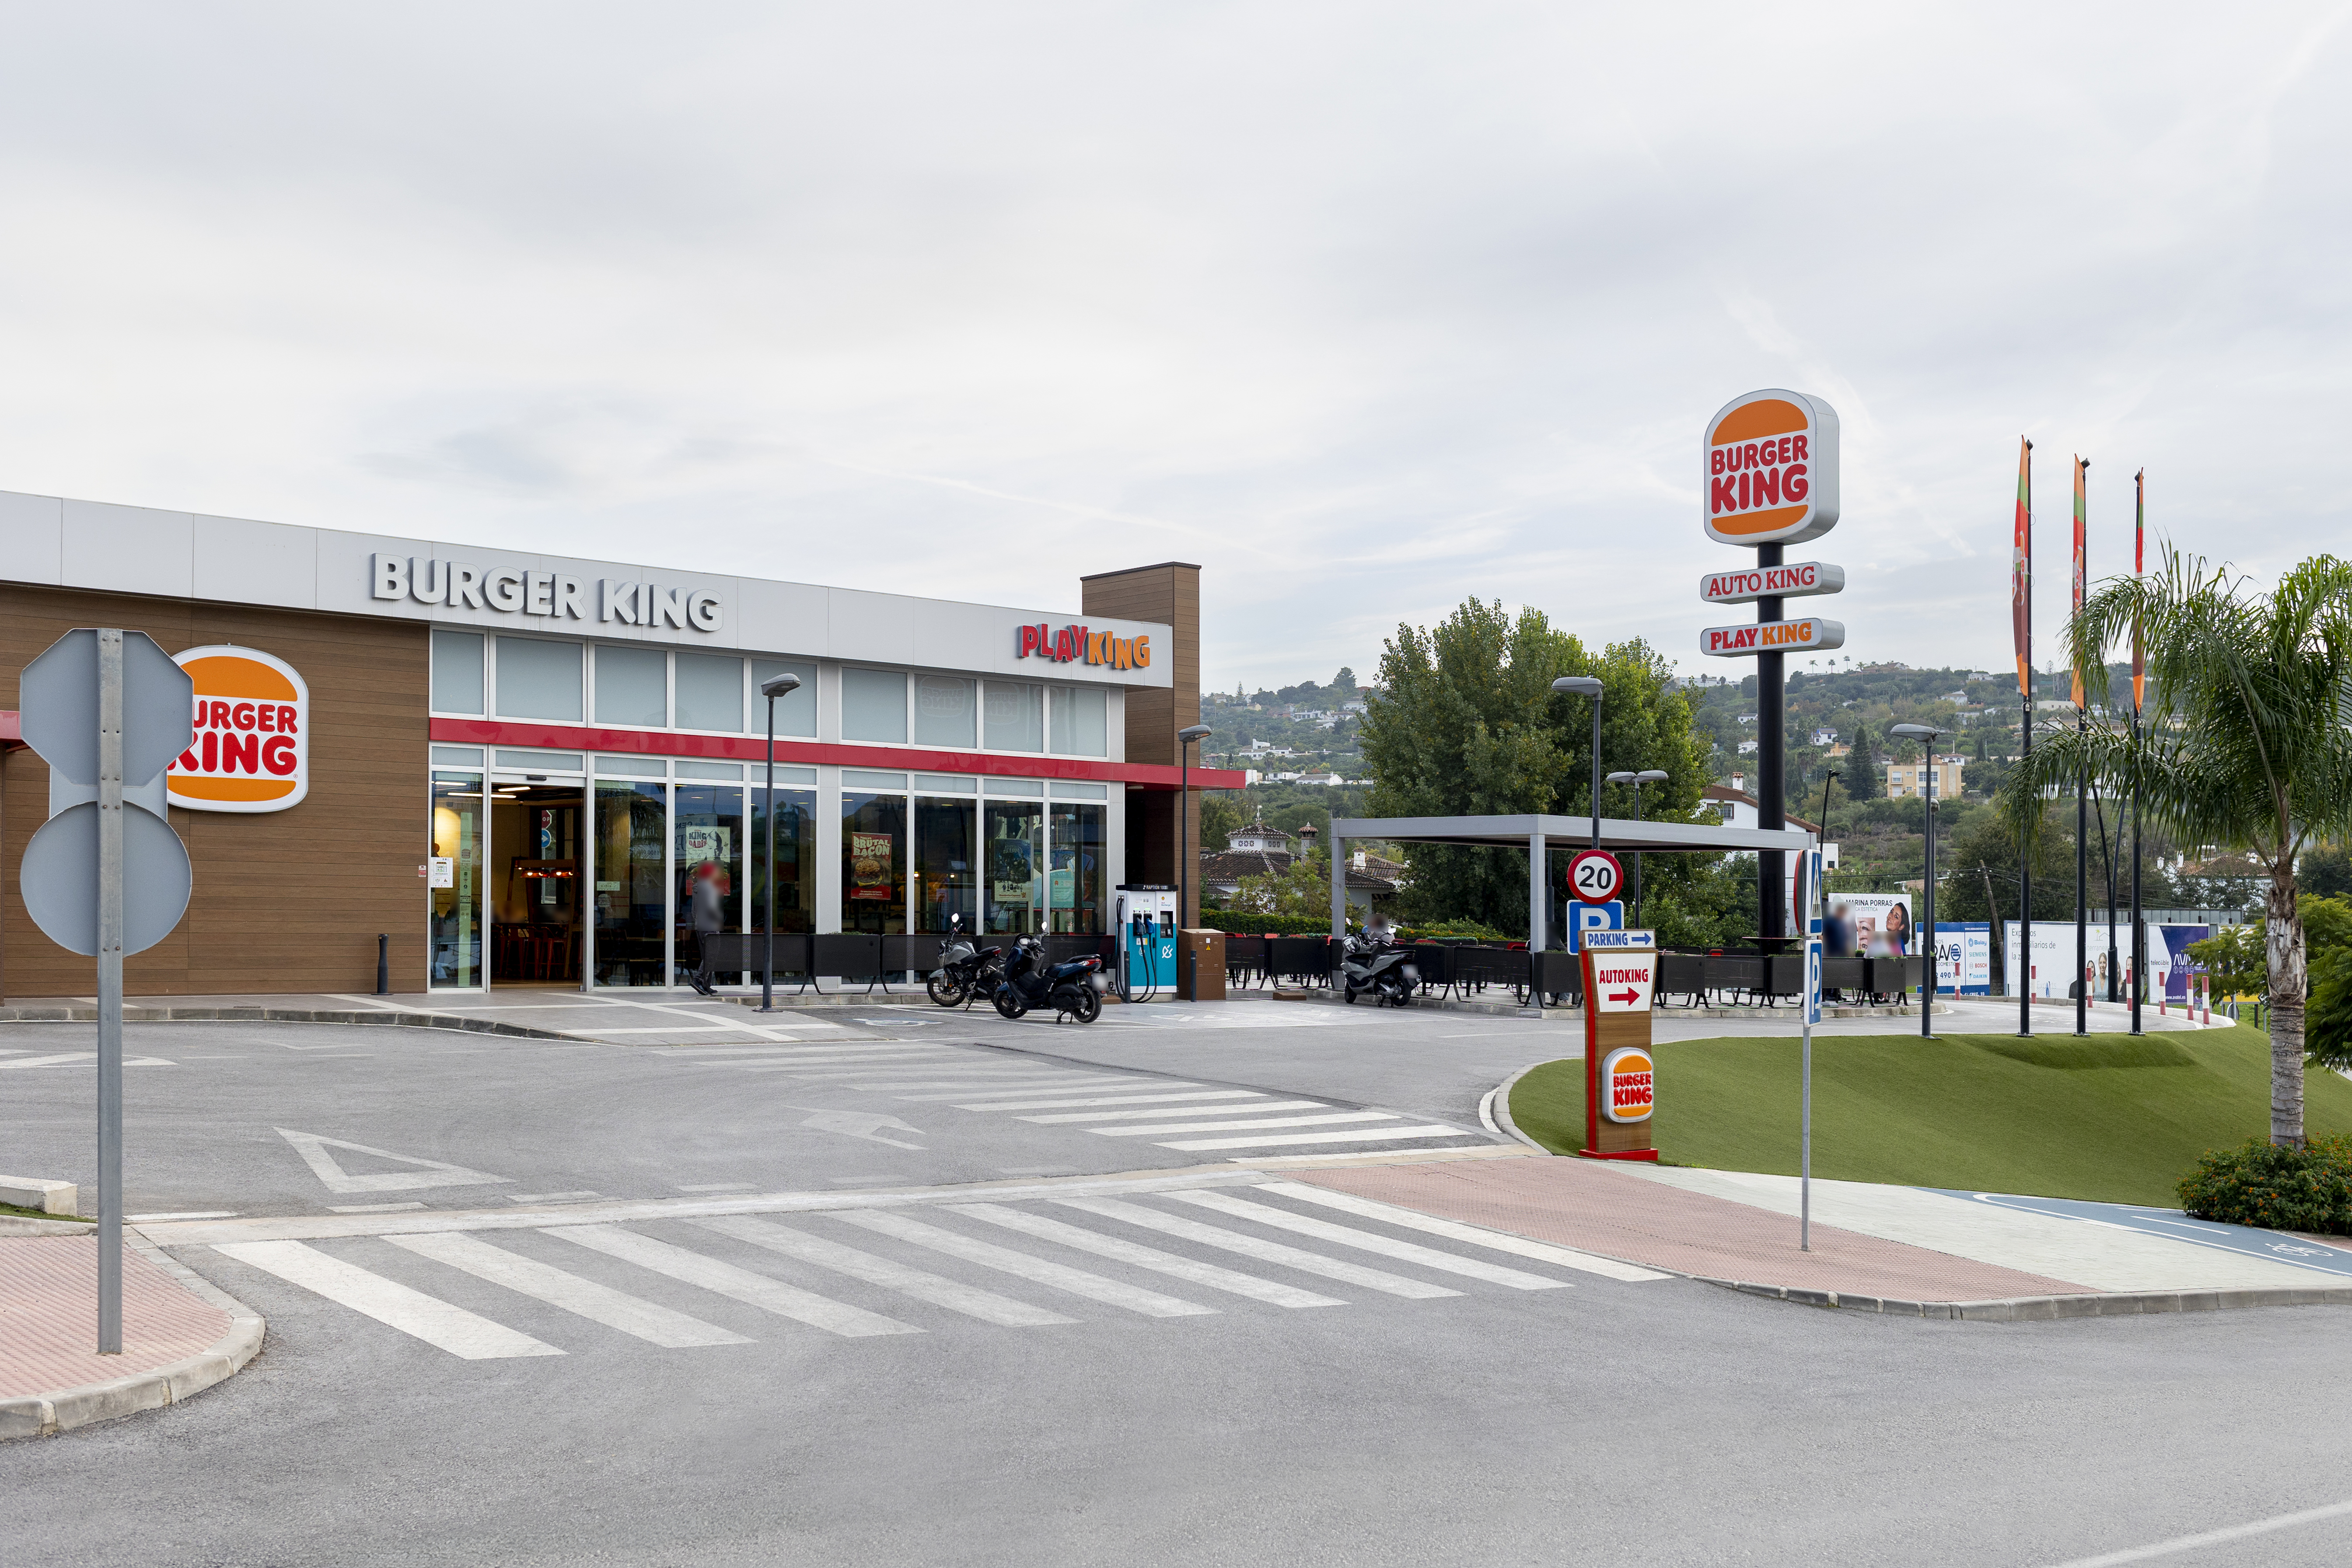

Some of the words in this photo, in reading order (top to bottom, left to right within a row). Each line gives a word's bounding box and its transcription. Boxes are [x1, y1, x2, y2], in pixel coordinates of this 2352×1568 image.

[1711, 435, 1808, 475] BURGER
[1711, 464, 1809, 514] KING
[1708, 573, 1761, 597] AUTO
[1766, 566, 1815, 590] KING
[371, 553, 587, 619] BURGER
[600, 579, 724, 632] KING
[1710, 628, 1758, 650] PLAY
[1762, 622, 1812, 646] KING
[193, 700, 298, 734] URGER
[688, 831, 706, 840] KING
[853, 836, 890, 849] BRUTAL
[853, 845, 890, 856] BACON
[1579, 865, 1611, 890] 20
[1588, 933, 1628, 946] PARKING
[2012, 928, 2036, 938] Expos
[1599, 969, 1648, 984] AUTOKING
[1613, 1073, 1652, 1088] BURGER
[1614, 1086, 1652, 1106] KING
